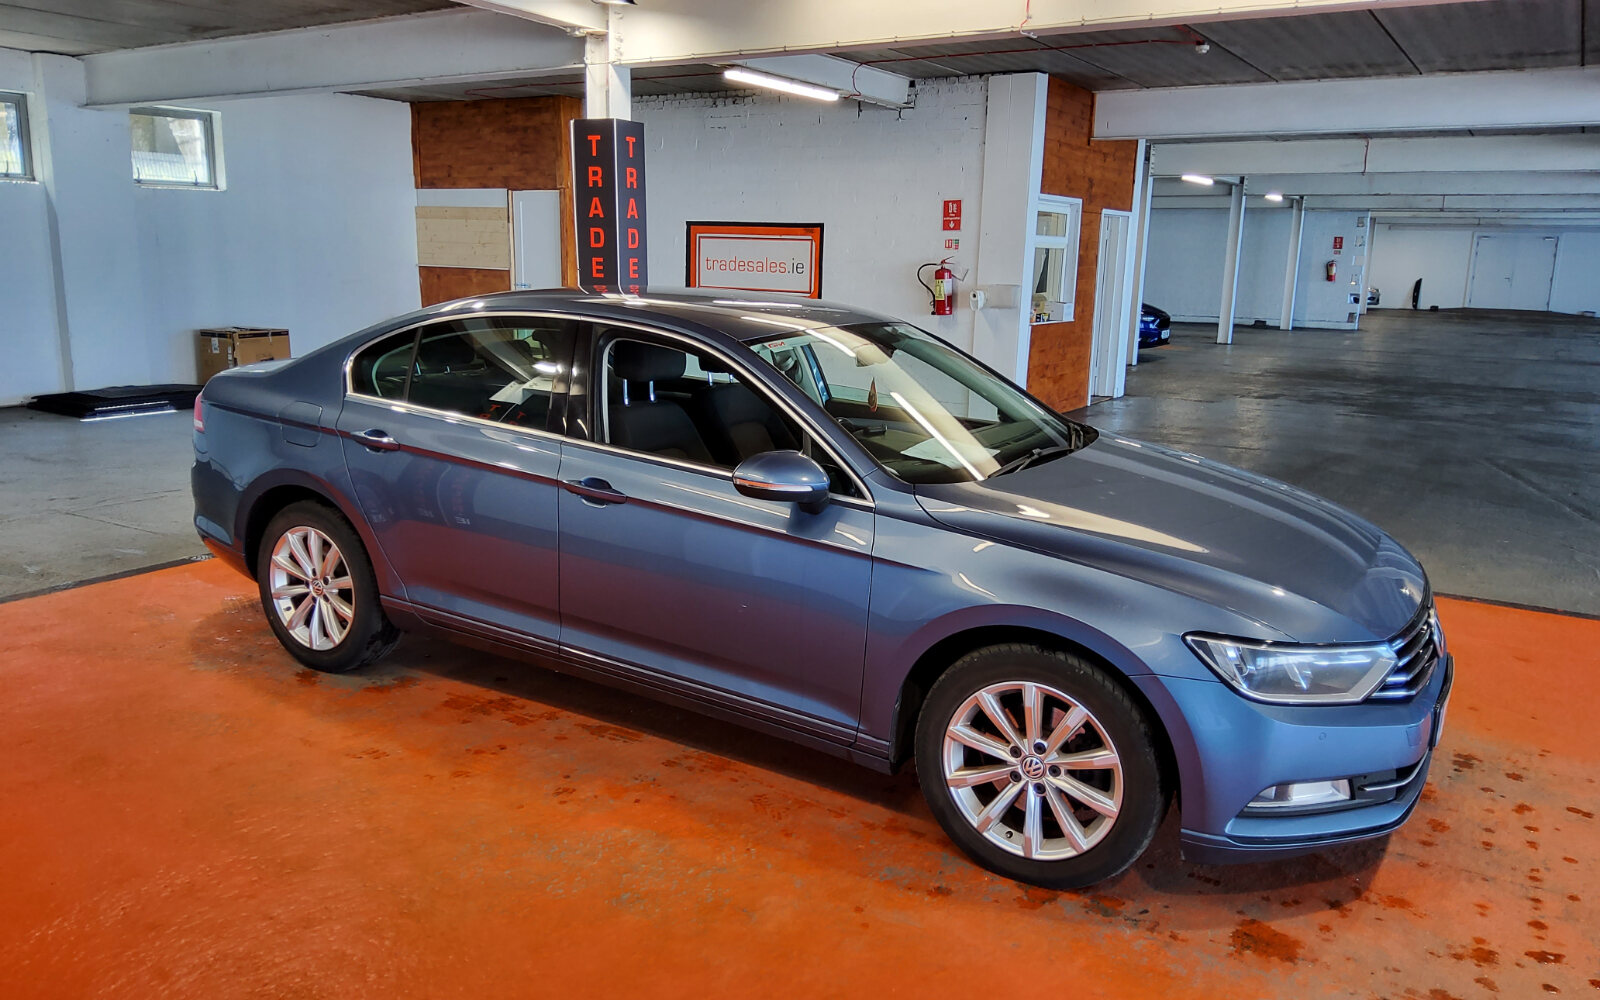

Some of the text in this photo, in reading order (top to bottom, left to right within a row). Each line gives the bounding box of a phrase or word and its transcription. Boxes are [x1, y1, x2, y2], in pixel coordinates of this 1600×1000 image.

[587, 135, 604, 278] TRADE
[625, 136, 639, 279] TRADE
[705, 256, 805, 274] tradesales.ie
